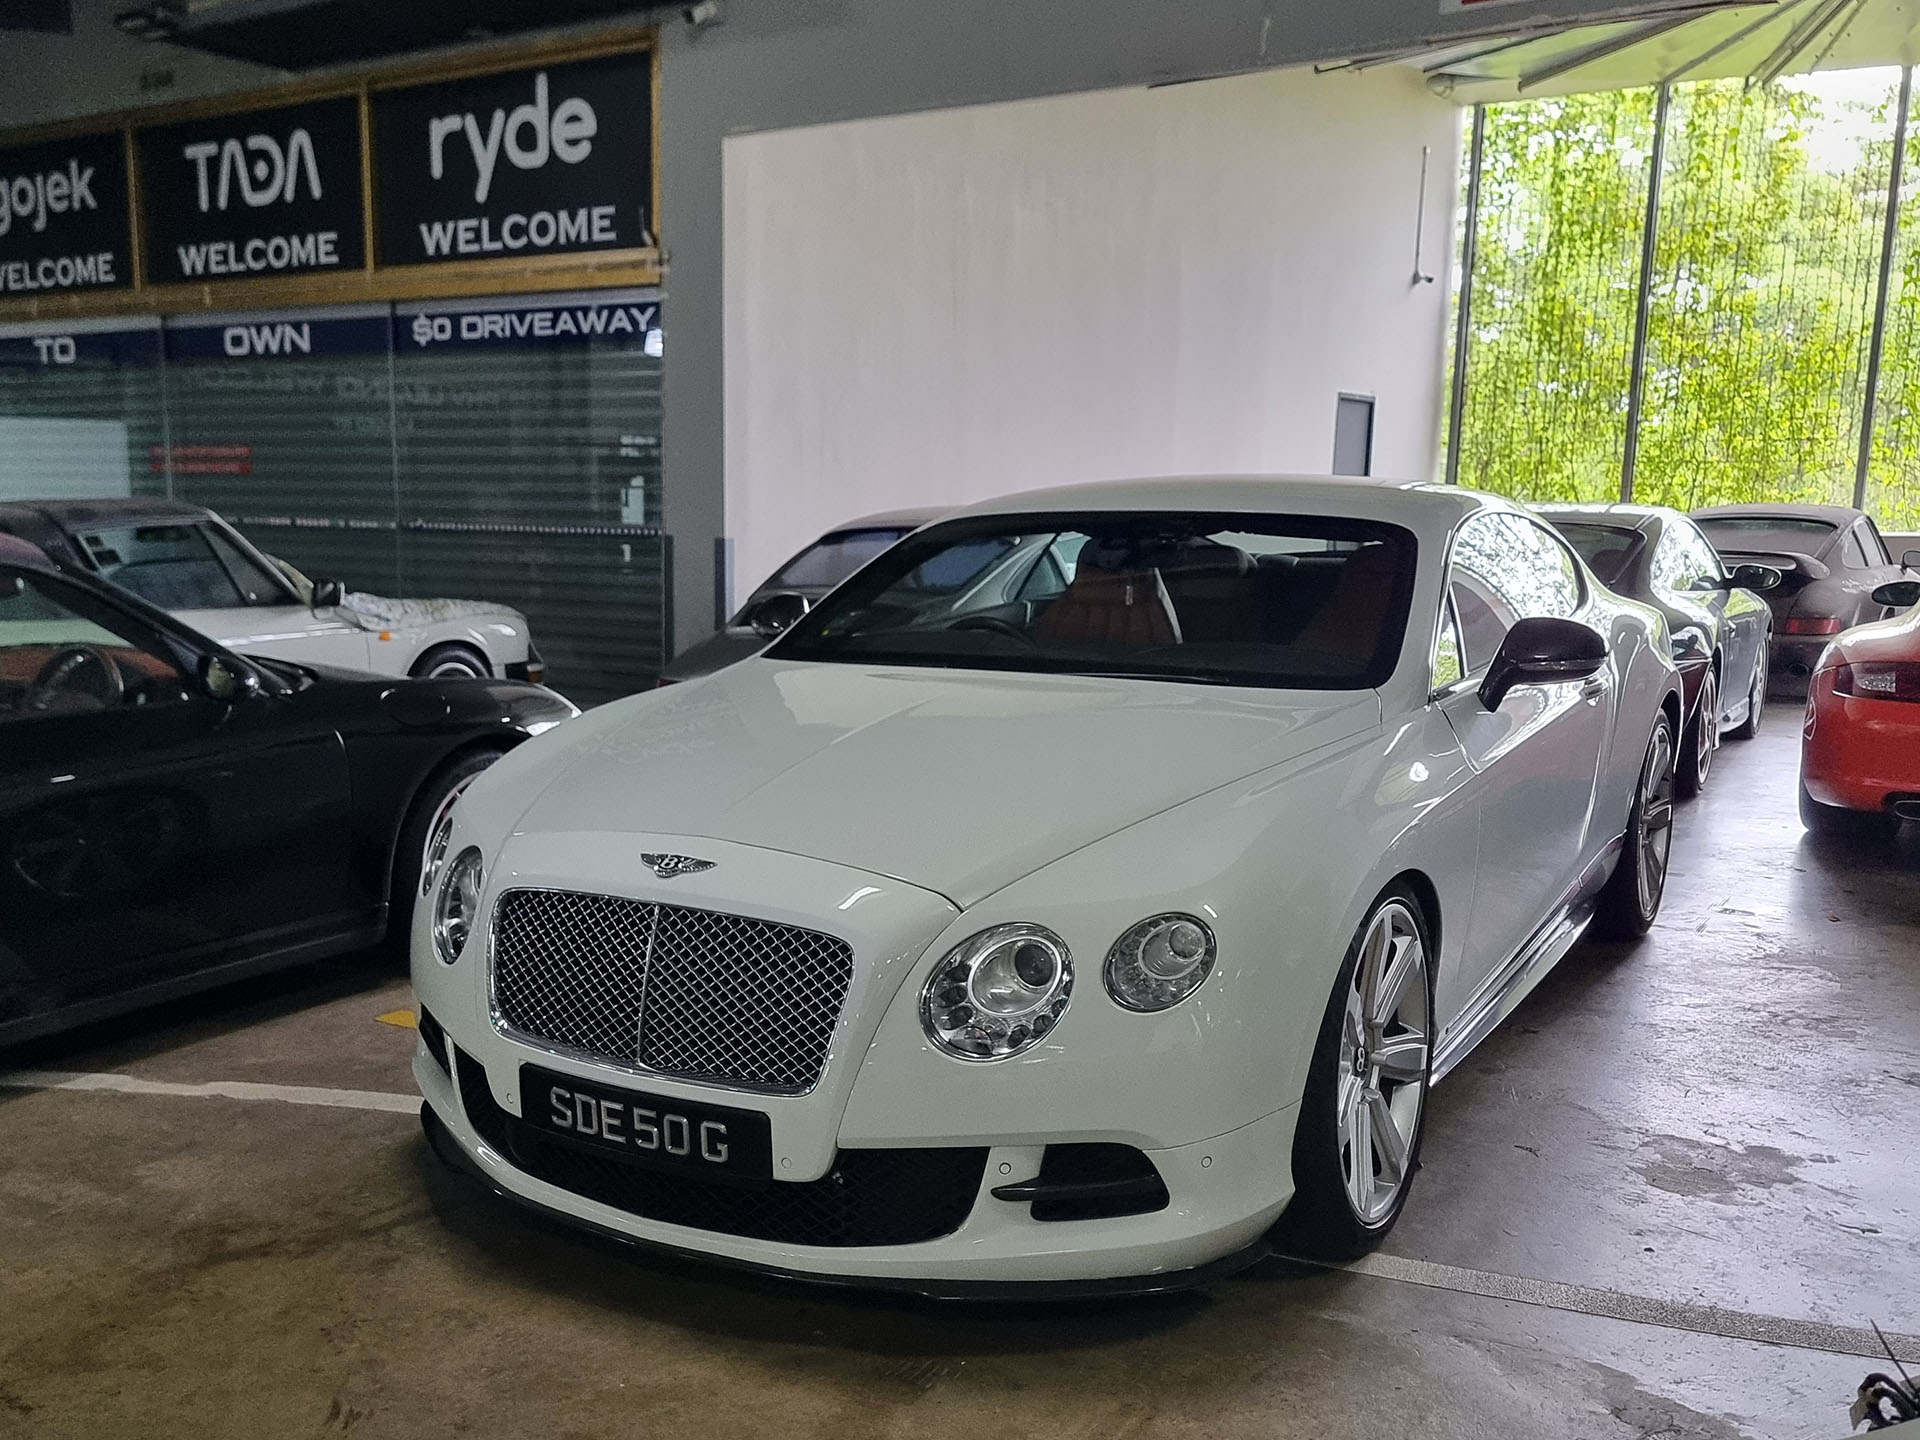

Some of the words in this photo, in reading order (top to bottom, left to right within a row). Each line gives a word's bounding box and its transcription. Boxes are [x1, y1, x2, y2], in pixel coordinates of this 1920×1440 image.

[183, 127, 323, 213] TADA
[429, 71, 598, 204] ryde
[177, 231, 339, 276] WELCOME
[419, 205, 617, 256] WELCOME
[34, 336, 76, 365] TO
[223, 322, 311, 357] OWN
[460, 306, 656, 340] DRIVEAWAY
[550, 1086, 627, 1144] SDE
[633, 1107, 691, 1155] 50
[700, 1120, 729, 1163] G
